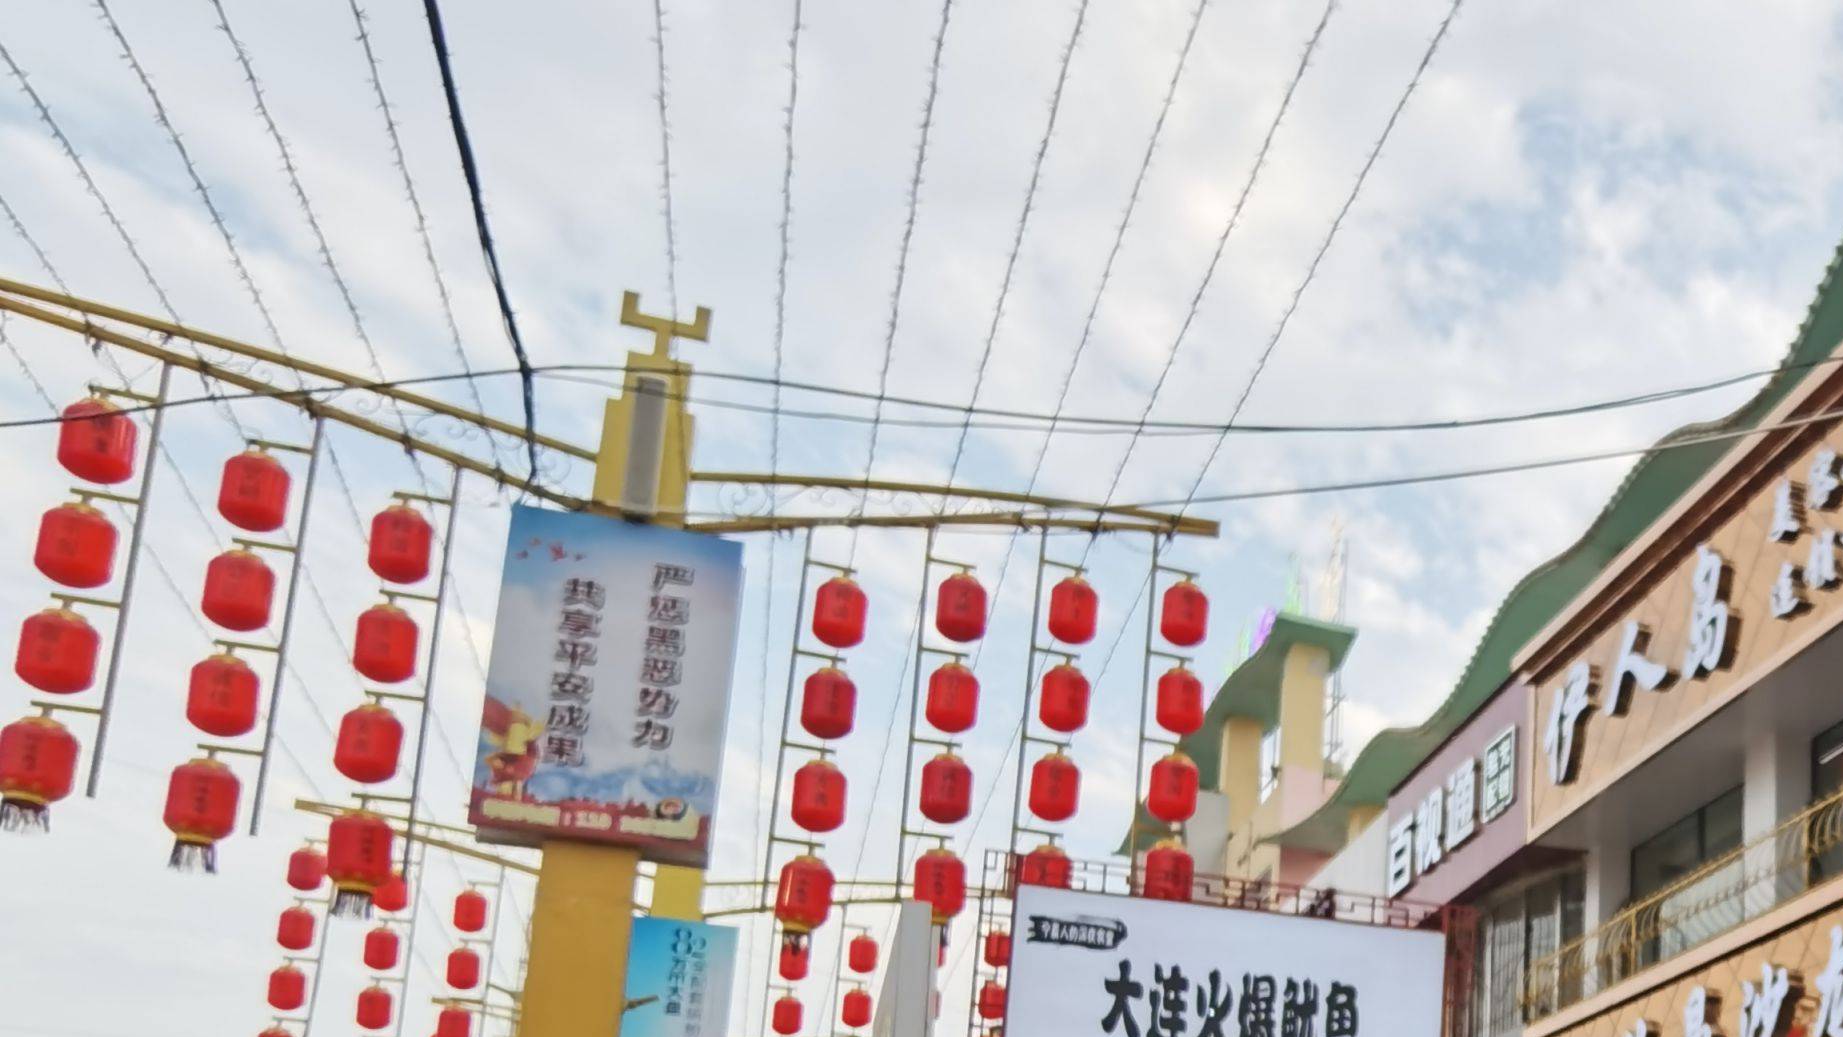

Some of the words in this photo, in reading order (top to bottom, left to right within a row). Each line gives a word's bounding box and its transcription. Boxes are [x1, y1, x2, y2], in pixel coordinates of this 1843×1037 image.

[543, 577, 605, 767] 共享平安成果
[632, 562, 695, 750] 严惩黑恶势力
